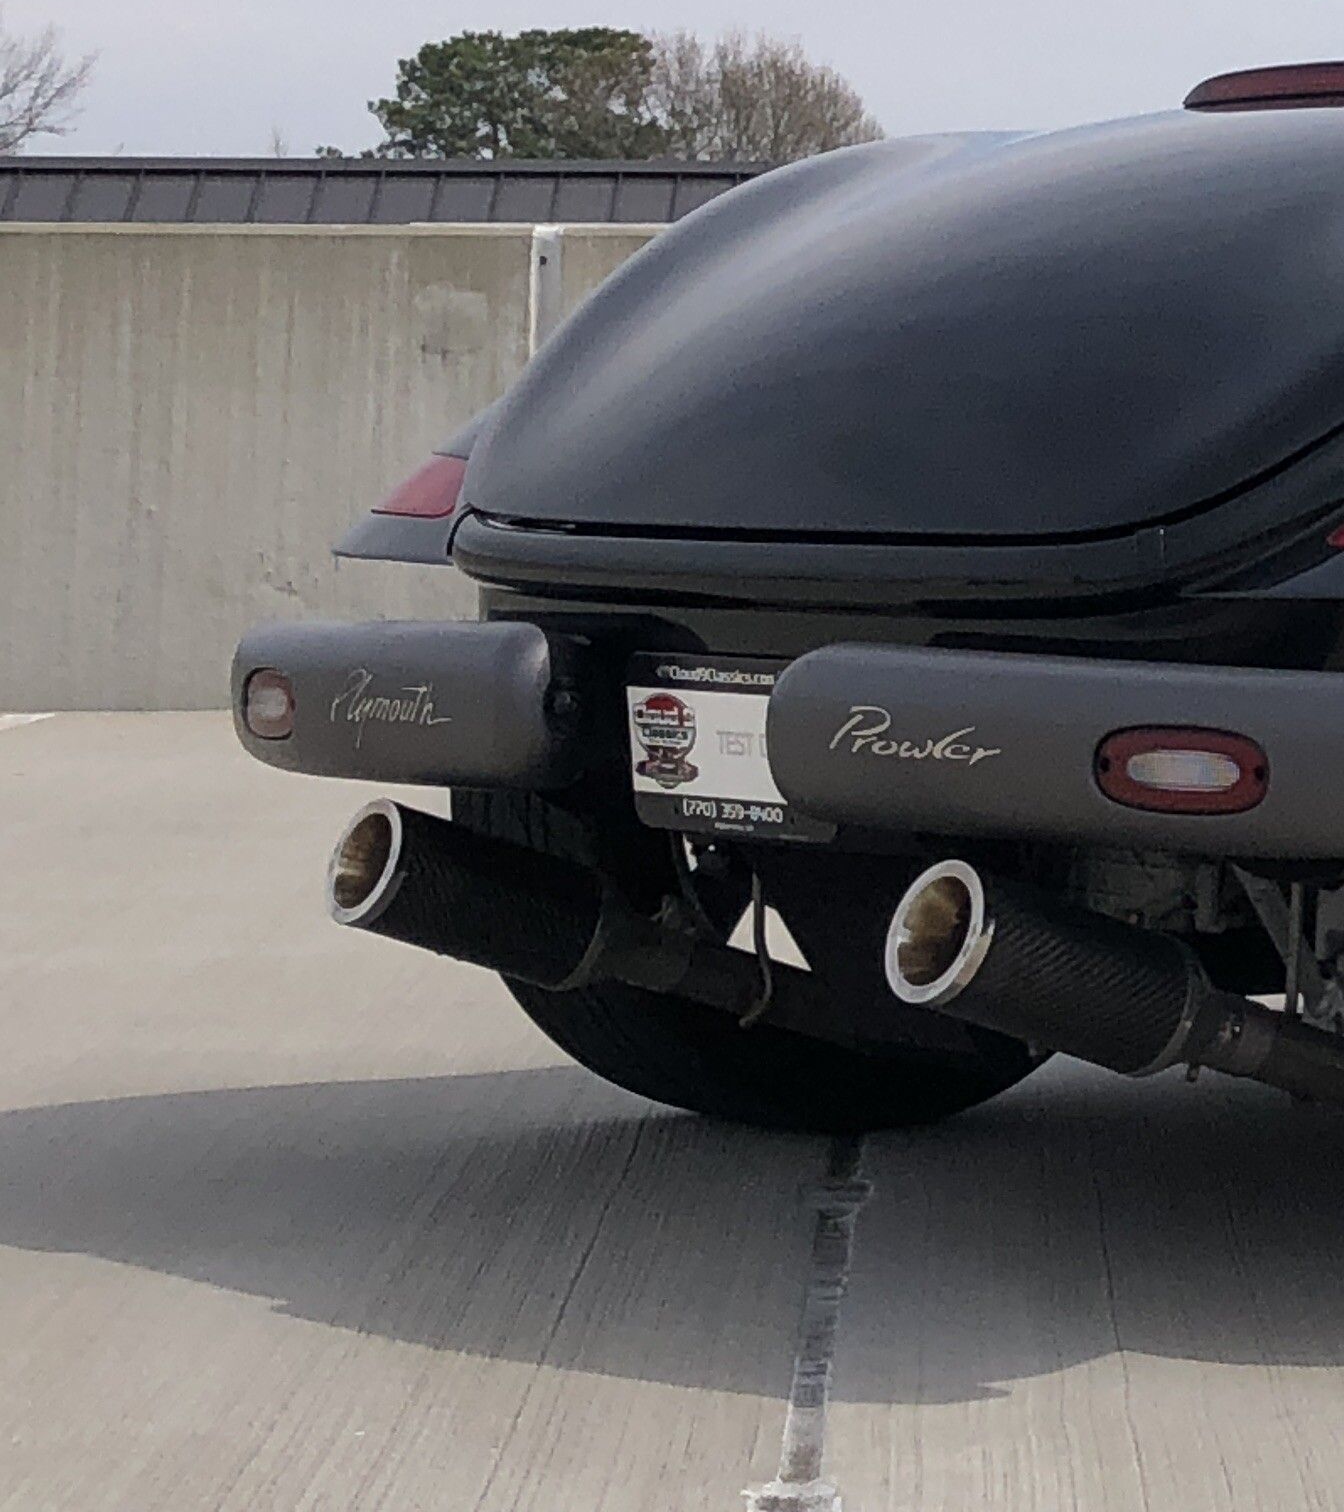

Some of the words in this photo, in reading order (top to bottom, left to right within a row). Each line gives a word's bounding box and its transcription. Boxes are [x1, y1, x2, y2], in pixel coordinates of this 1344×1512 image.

[329, 664, 453, 749] Plymouth
[828, 705, 1002, 766] Prowler
[715, 730, 754, 756] TEST
